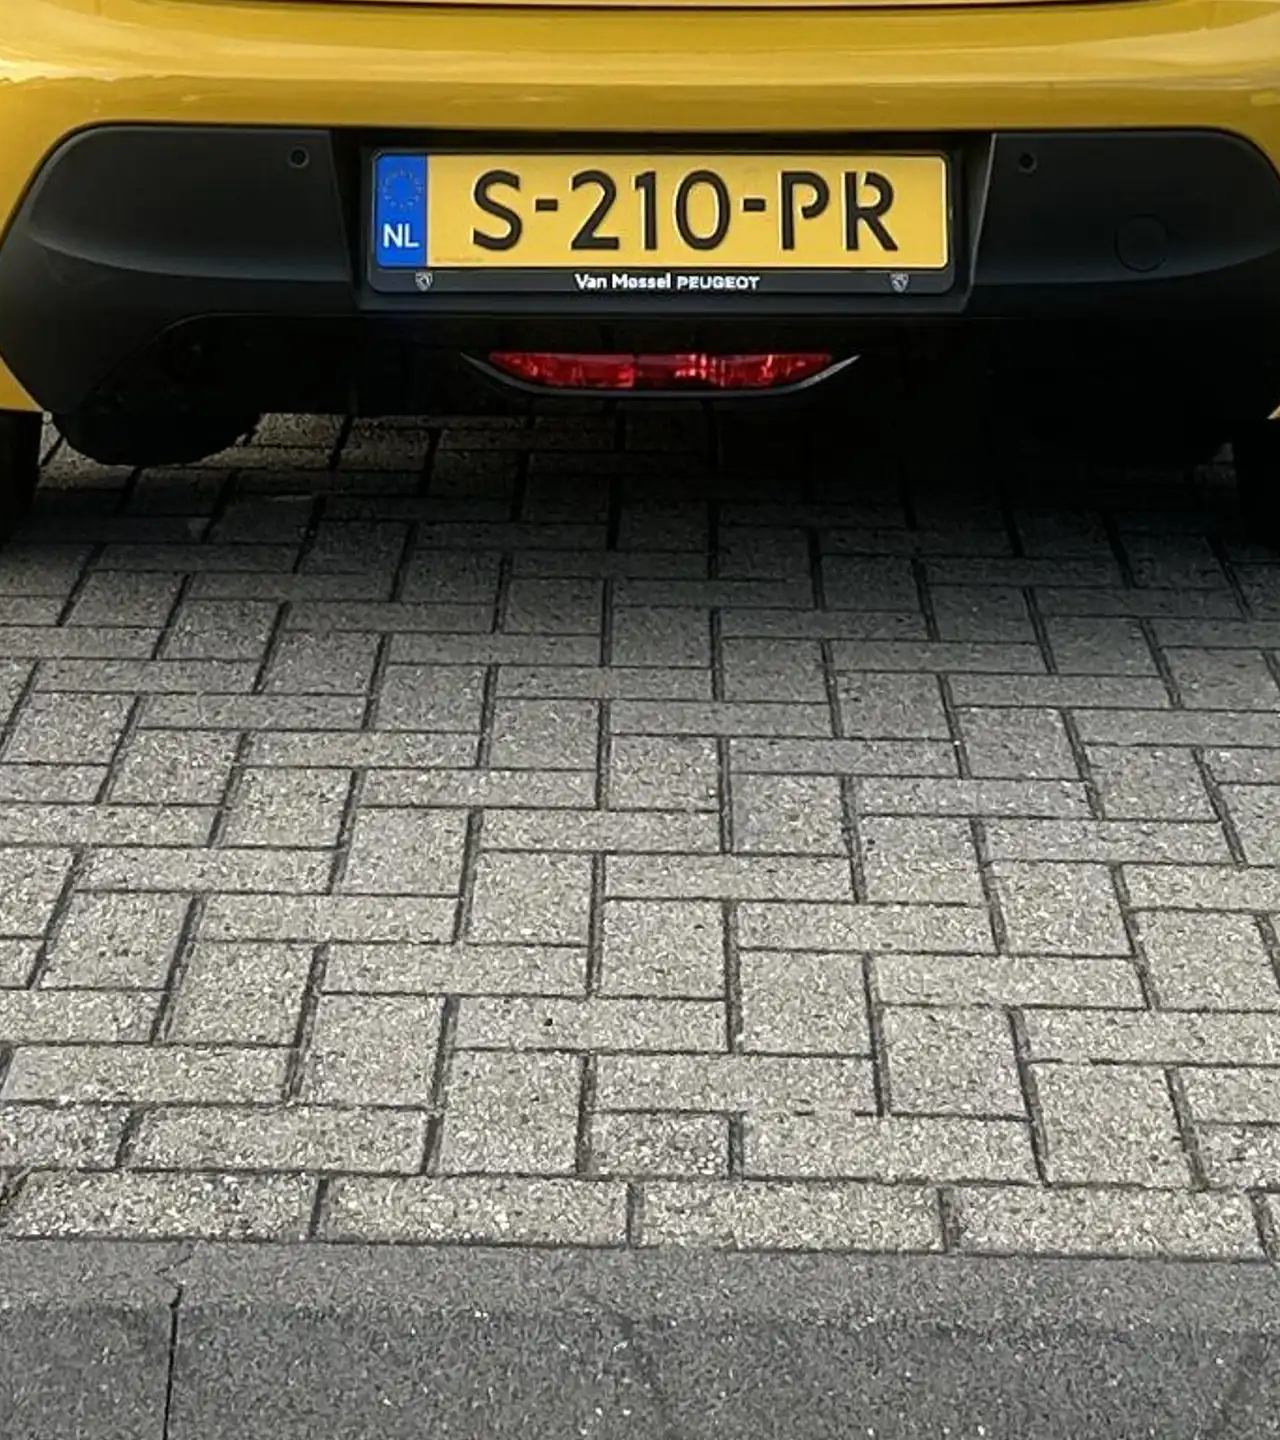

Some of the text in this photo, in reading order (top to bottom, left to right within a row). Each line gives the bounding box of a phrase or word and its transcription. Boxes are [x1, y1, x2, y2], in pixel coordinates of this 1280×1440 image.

[471, 168, 899, 253] S-210-PR
[382, 222, 421, 249] NL
[574, 272, 761, 291] Van Mossel PEUGEOT
